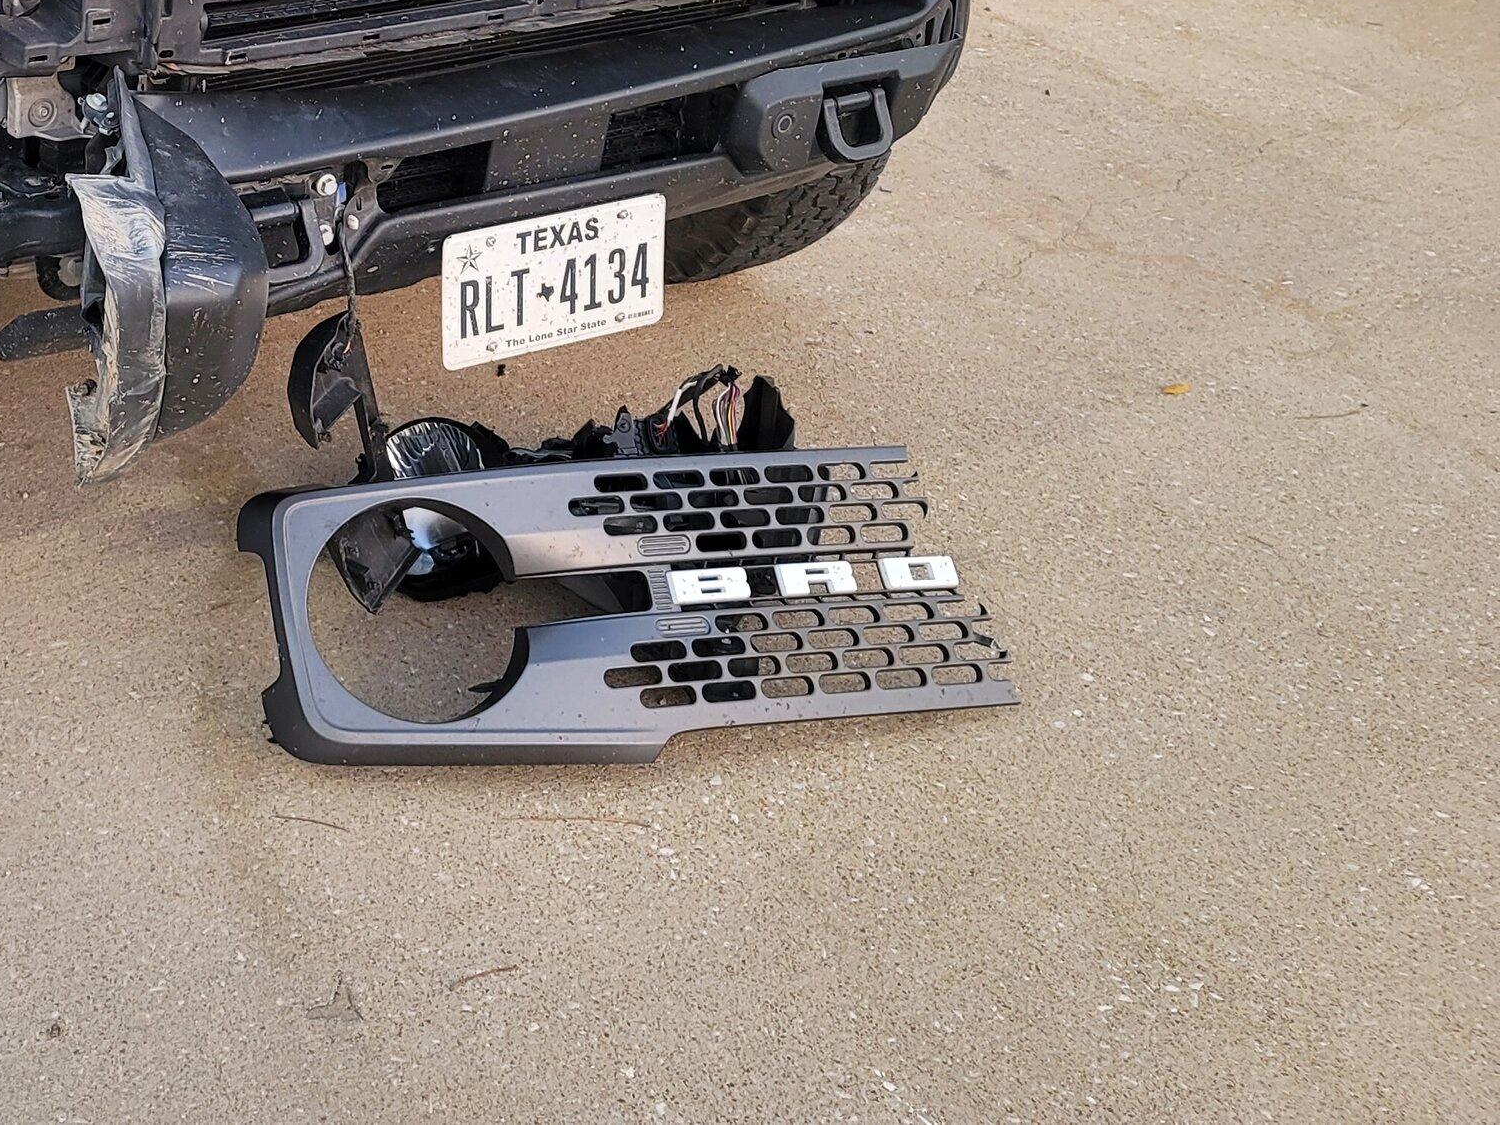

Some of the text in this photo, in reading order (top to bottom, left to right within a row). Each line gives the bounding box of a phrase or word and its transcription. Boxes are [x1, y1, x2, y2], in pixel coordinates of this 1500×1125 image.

[516, 217, 600, 255] TEXAS
[460, 243, 650, 339] RLT 4134
[505, 319, 607, 348] The Lone Star State
[666, 555, 960, 605] BRO
